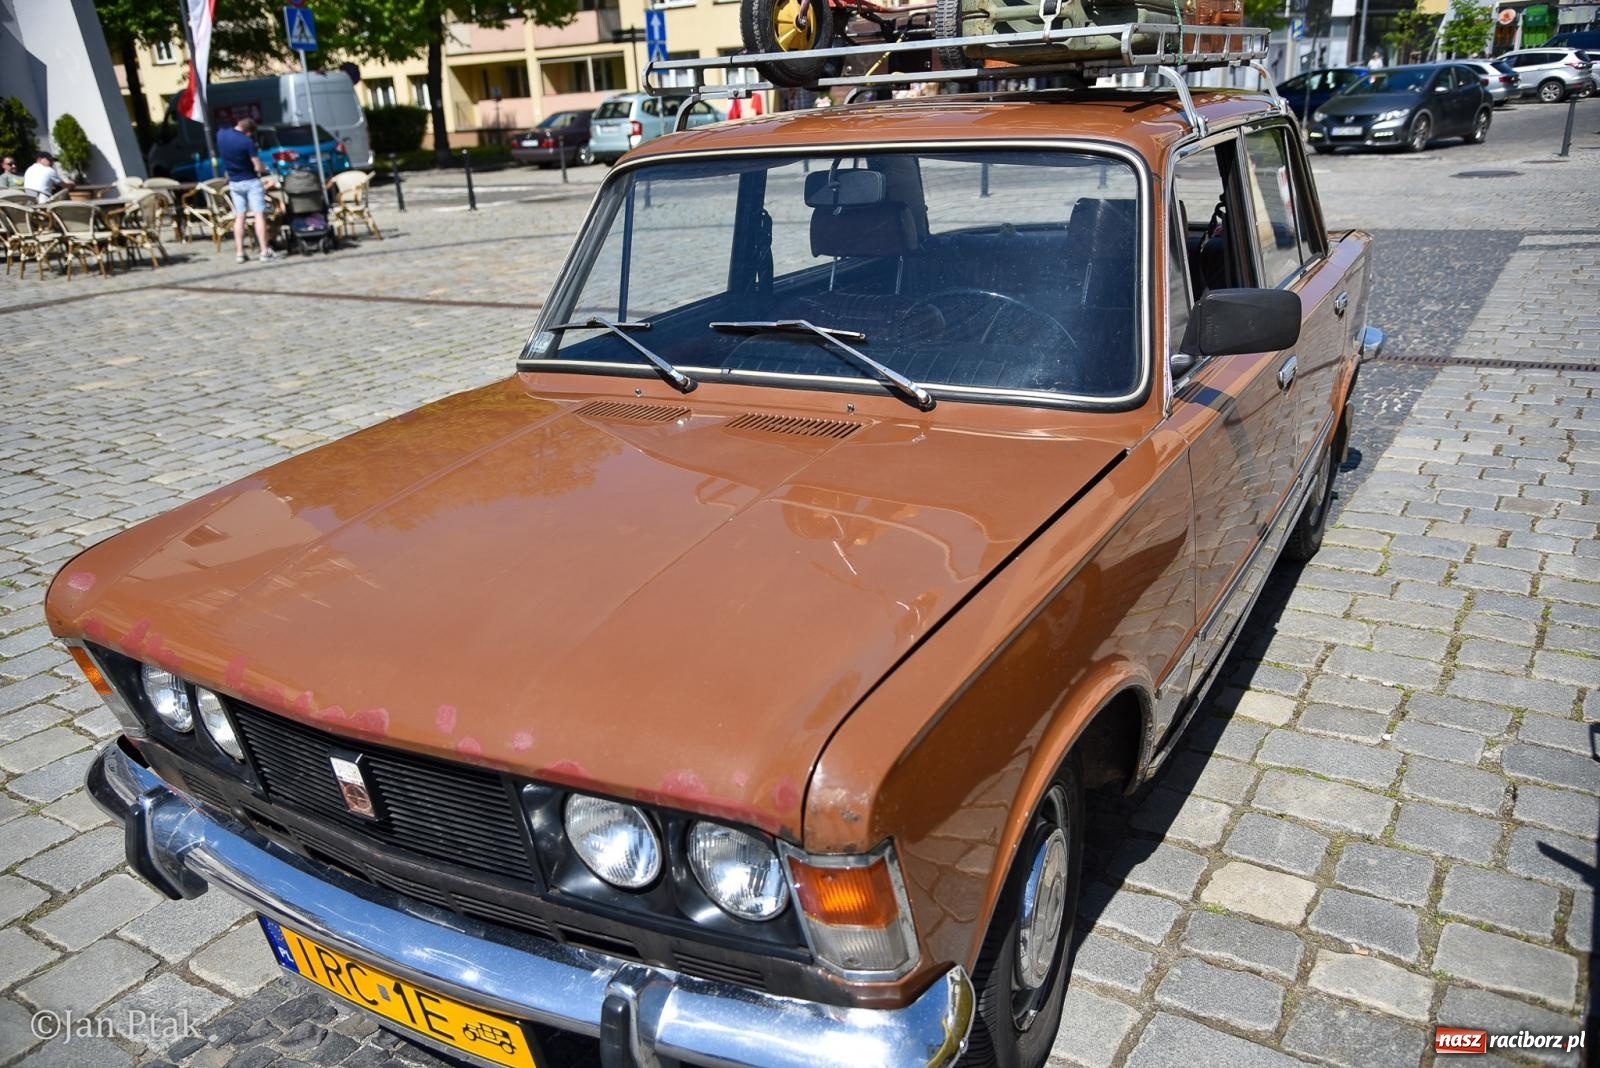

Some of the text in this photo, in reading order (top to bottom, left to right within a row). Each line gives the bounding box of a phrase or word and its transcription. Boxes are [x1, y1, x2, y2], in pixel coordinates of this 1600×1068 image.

[277, 945, 294, 963] PL
[296, 937, 455, 1041] IRC 1E
